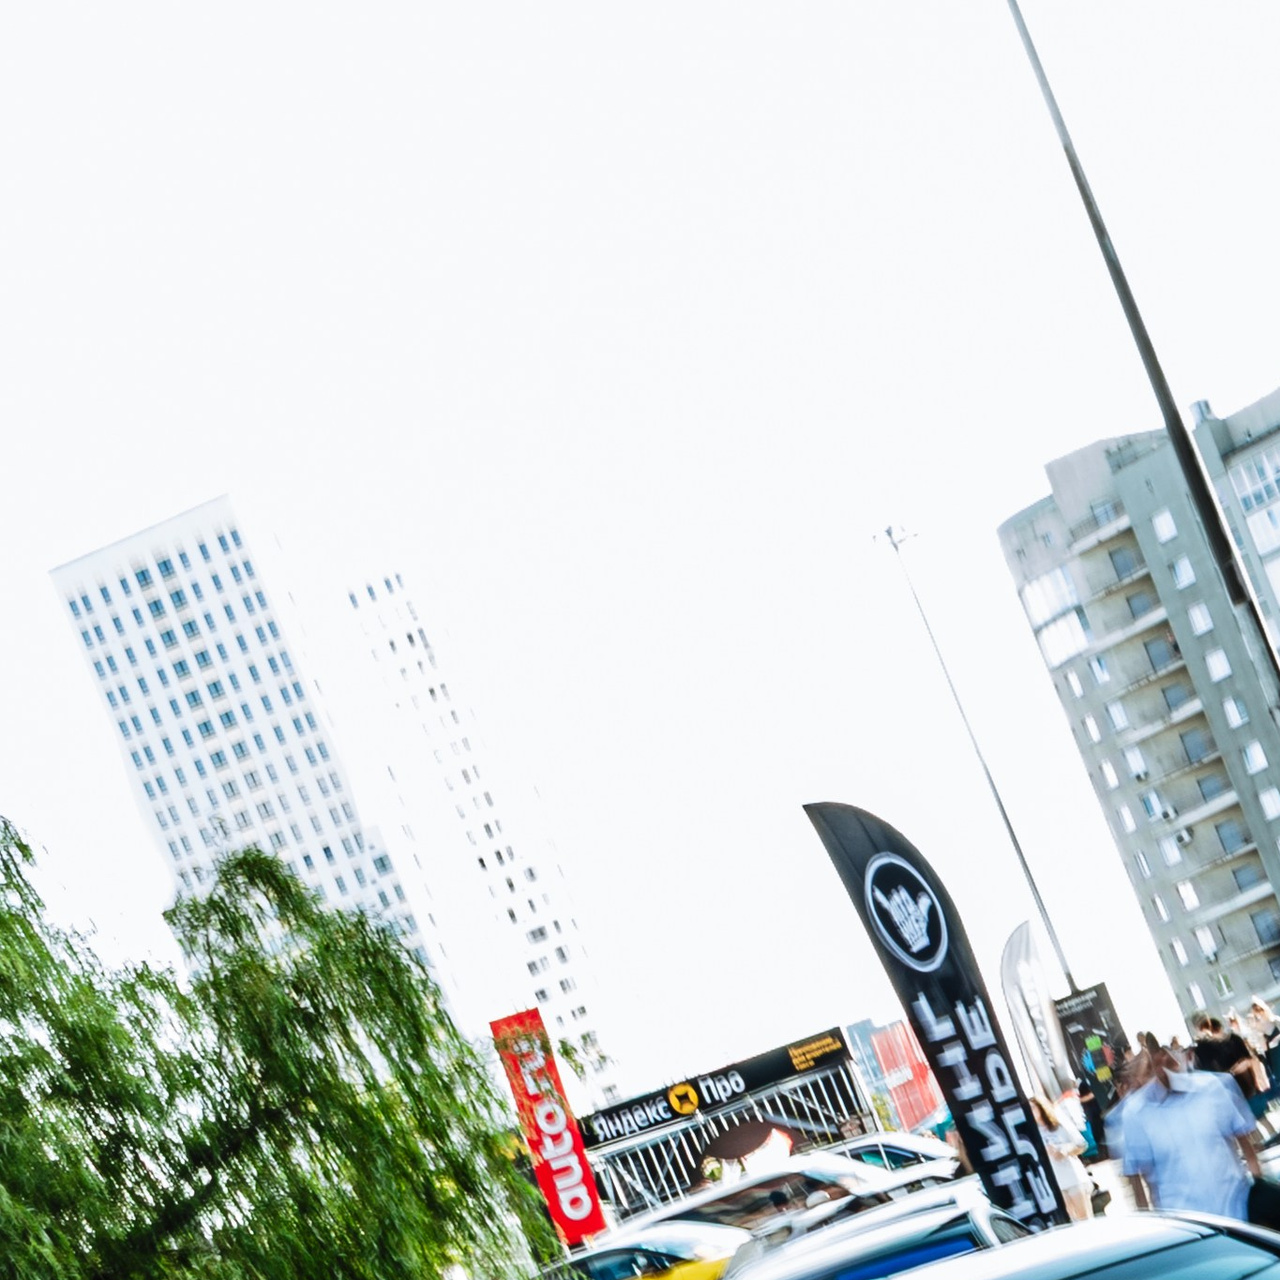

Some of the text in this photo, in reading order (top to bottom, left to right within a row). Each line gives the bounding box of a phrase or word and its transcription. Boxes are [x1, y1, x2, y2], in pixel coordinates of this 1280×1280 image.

[593, 1069, 746, 1142] Яндекс Про
[913, 991, 1044, 1231] НИНГ
[954, 996, 1060, 1228] ЕЛЬЕ
